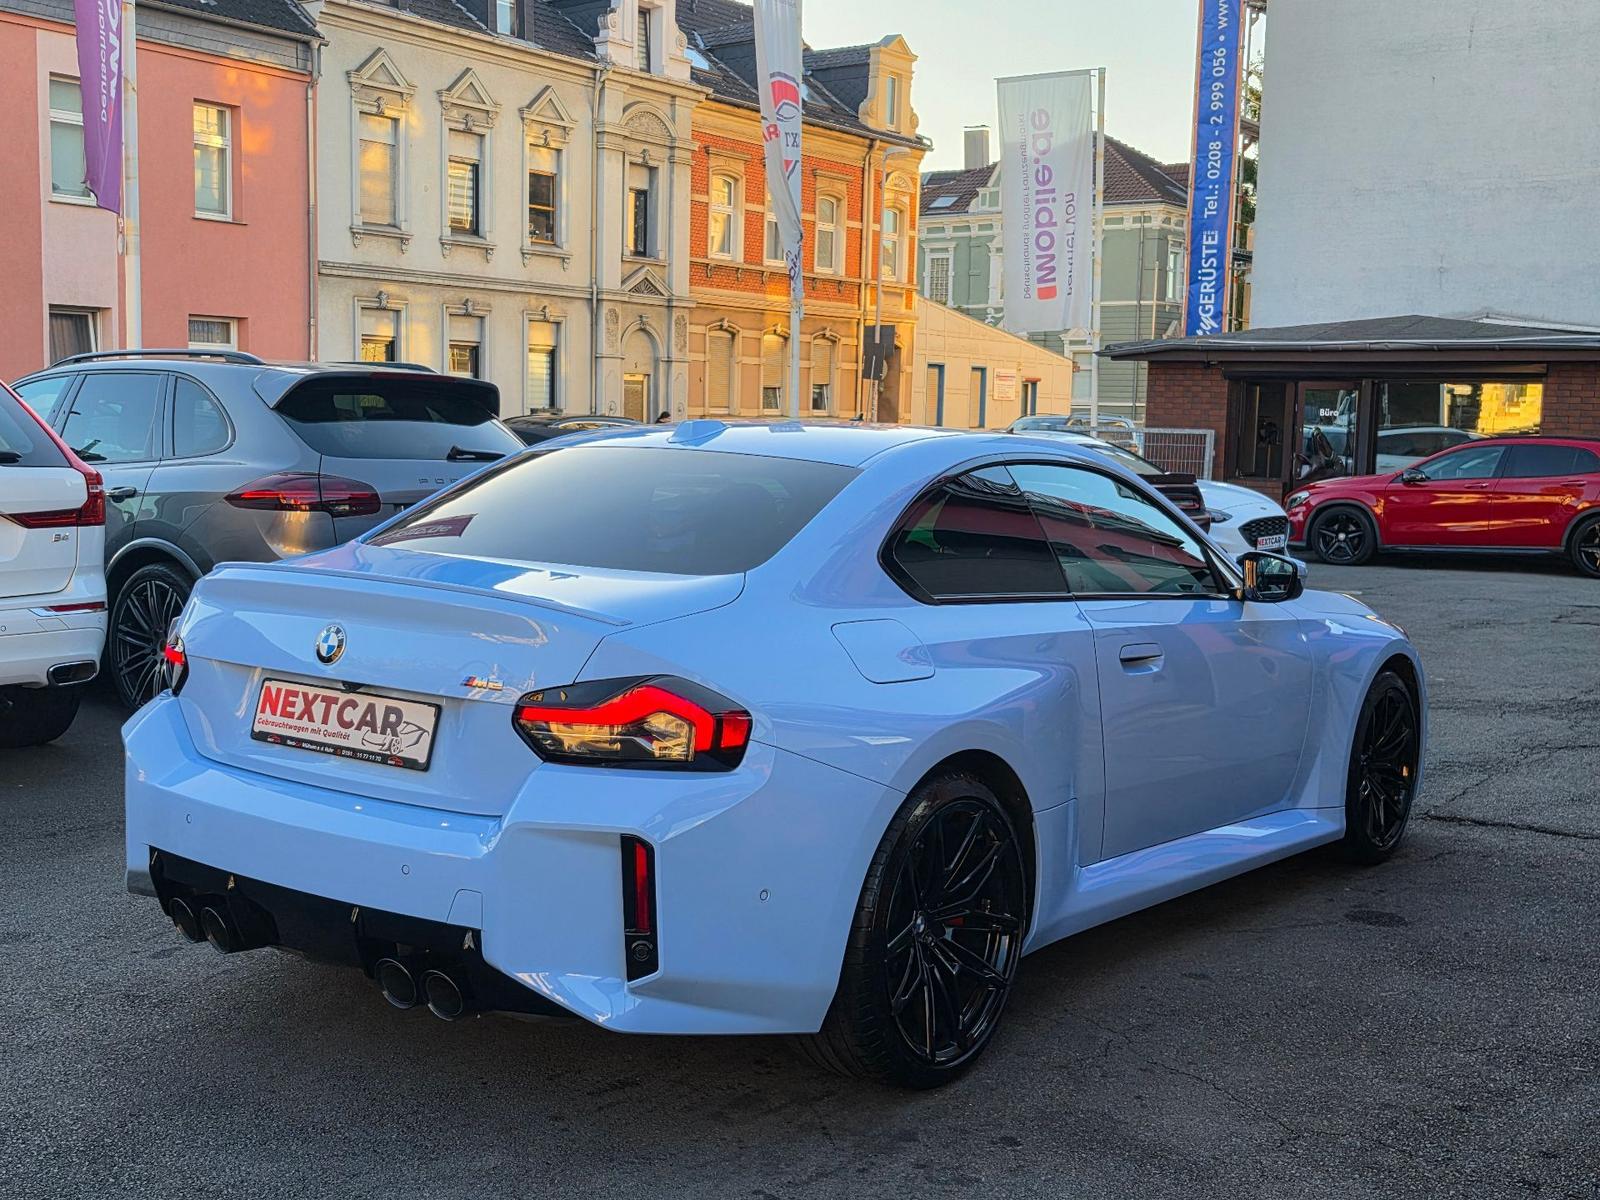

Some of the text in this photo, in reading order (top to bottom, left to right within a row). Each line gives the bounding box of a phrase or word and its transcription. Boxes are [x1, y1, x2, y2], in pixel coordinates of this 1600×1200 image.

[1211, 47, 1226, 77] 056
[1211, 81, 1225, 111] 999
[1210, 115, 1223, 124] 2
[1207, 141, 1222, 179] 0208
[1204, 184, 1220, 218] Tel.:
[1319, 408, 1339, 417] Büro
[259, 684, 404, 738] NEXTCAR
[256, 717, 351, 741] Gebrauchtwagen mit Qualität
